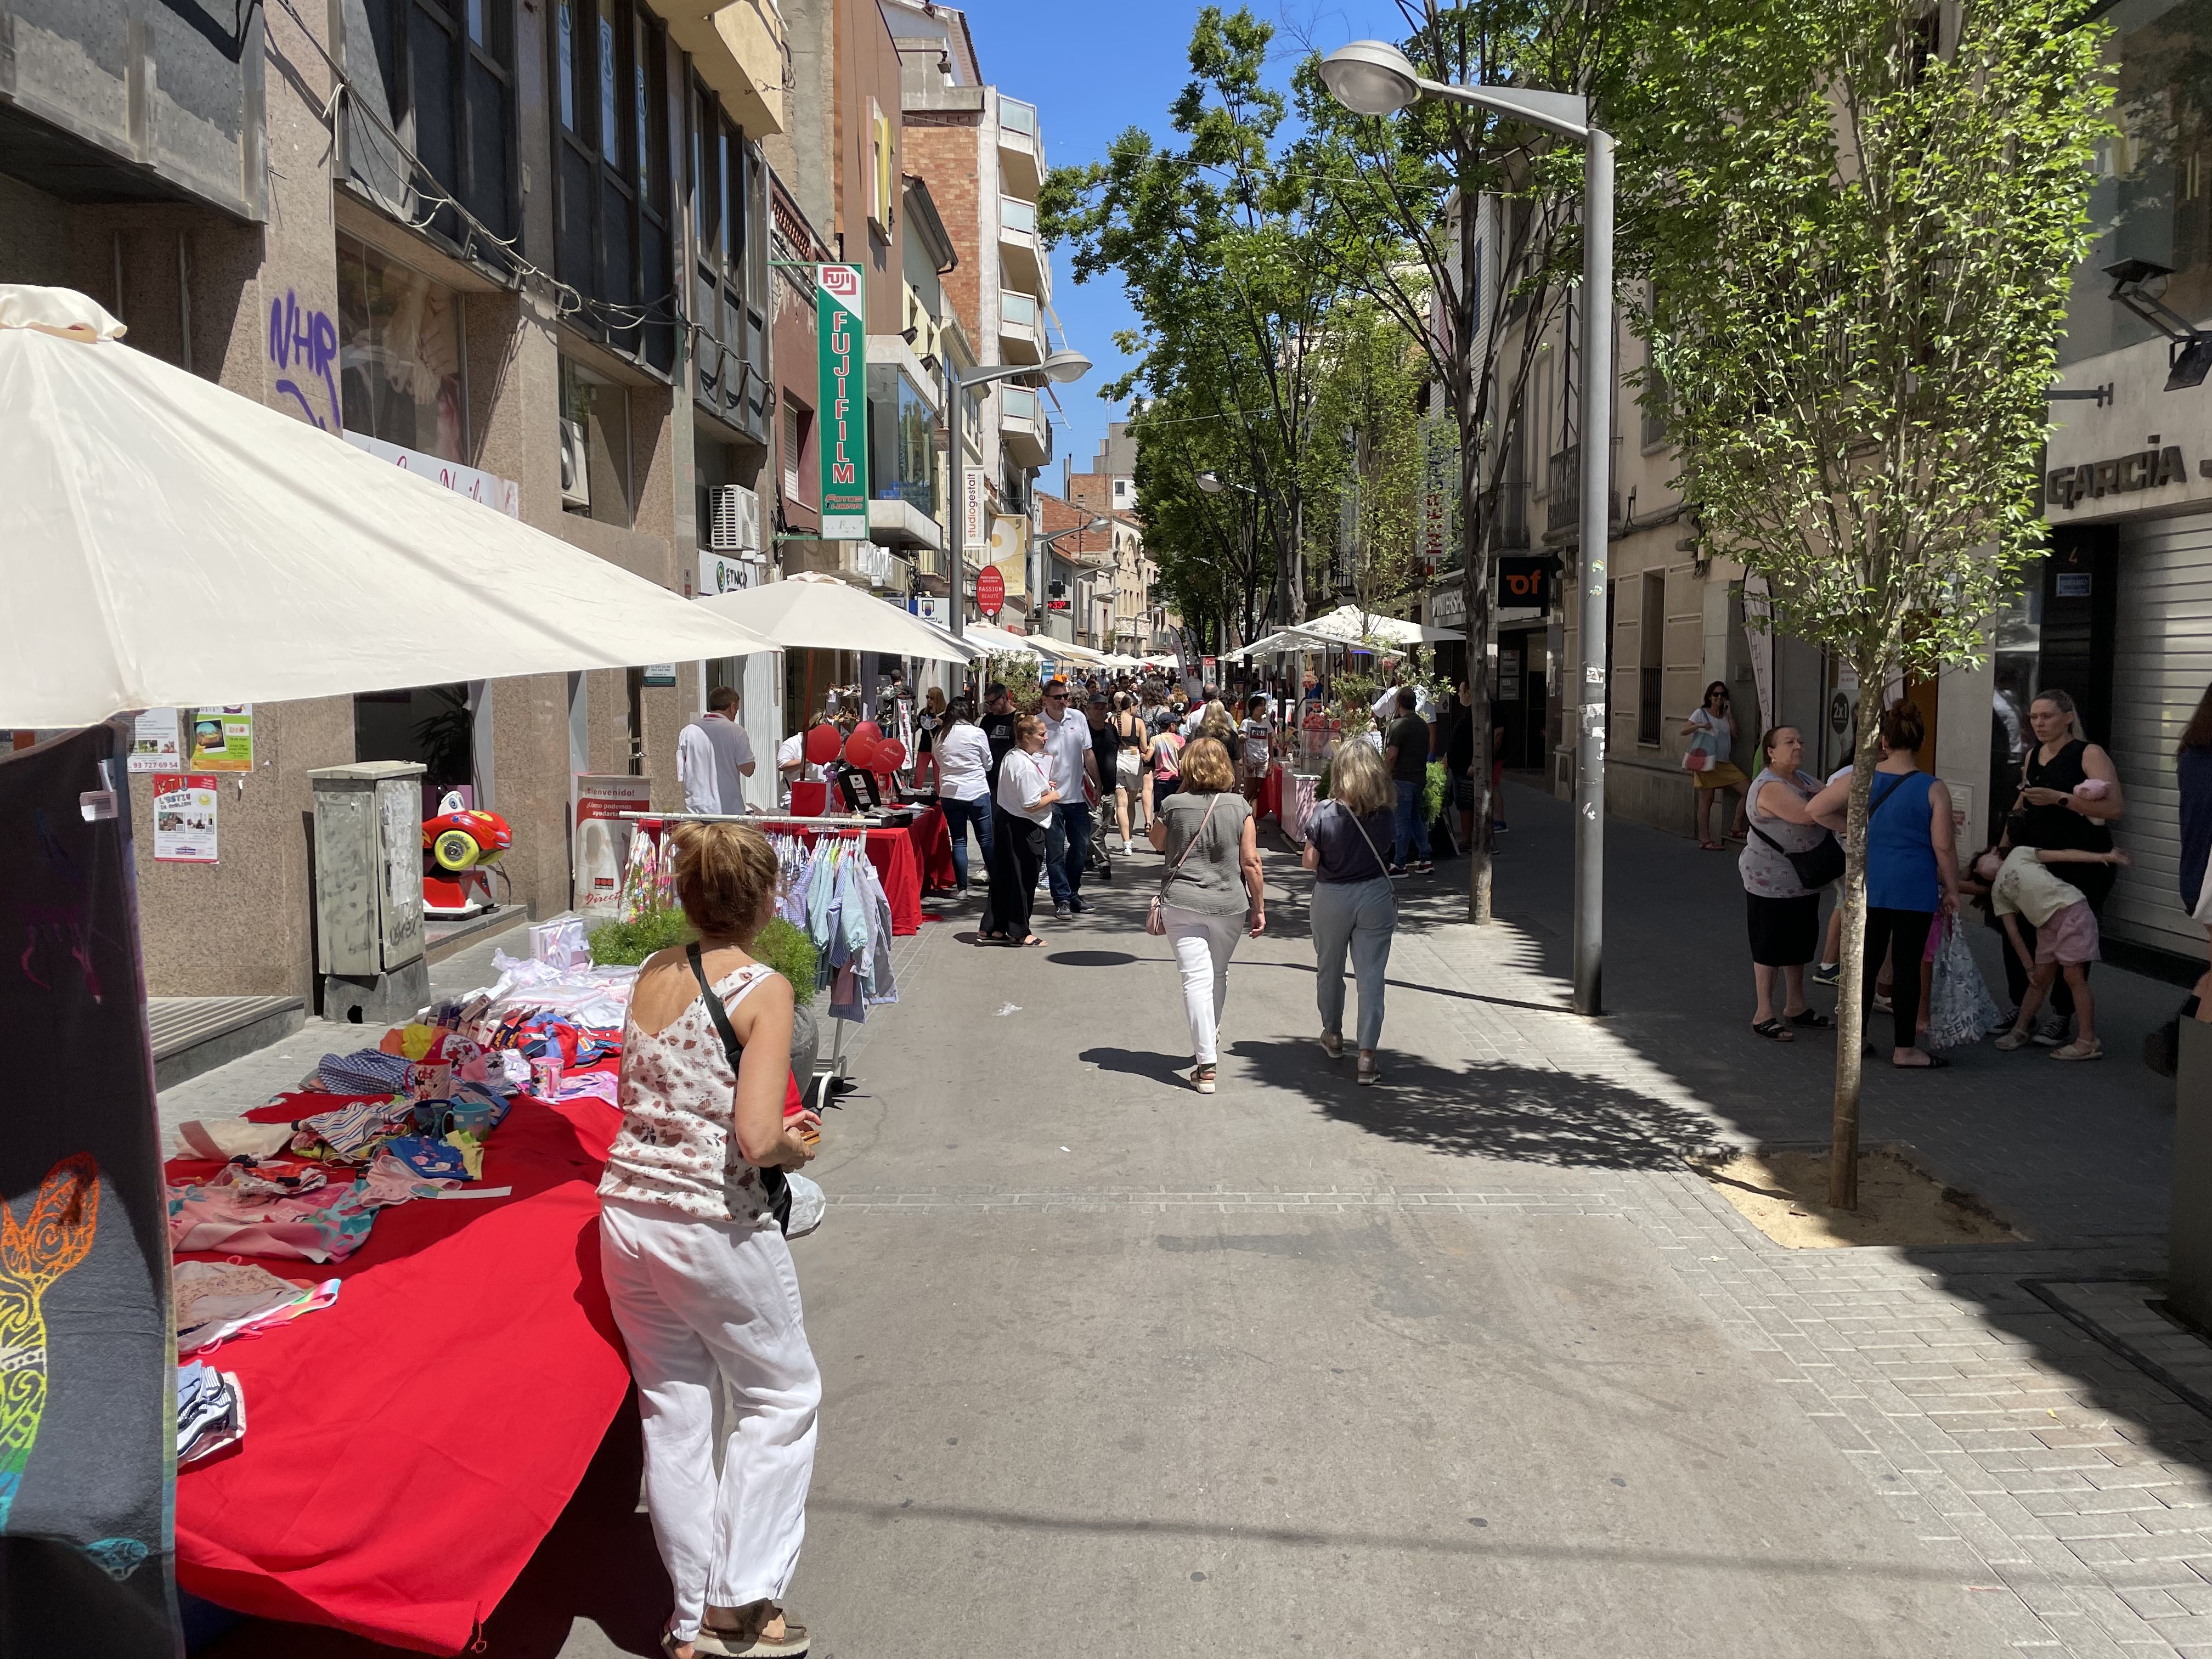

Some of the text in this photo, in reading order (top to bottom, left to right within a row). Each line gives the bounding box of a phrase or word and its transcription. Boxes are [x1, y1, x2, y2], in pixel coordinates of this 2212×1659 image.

[823, 267, 854, 291] FUJI
[832, 311, 854, 484] FUJIFILM
[967, 473, 978, 538] studiogestalt
[156, 777, 188, 794] VIU
[585, 787, 634, 796] ¡Bienvenido!
